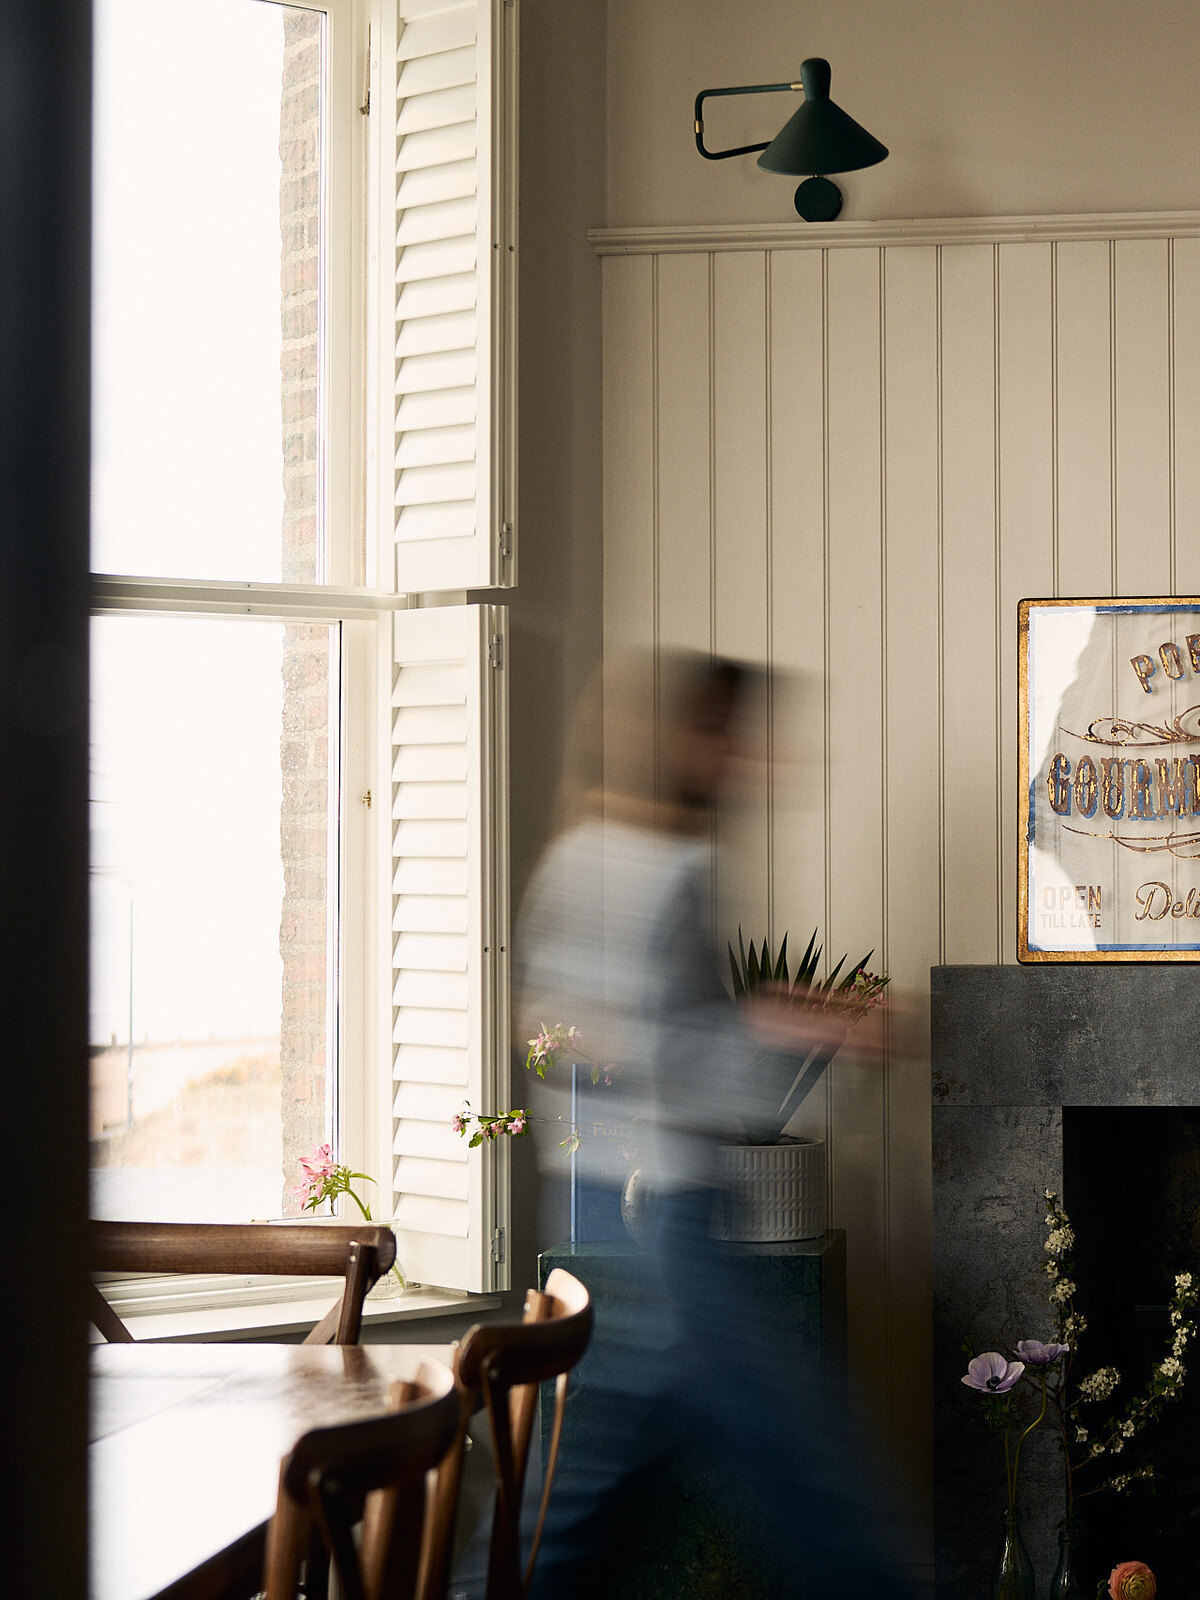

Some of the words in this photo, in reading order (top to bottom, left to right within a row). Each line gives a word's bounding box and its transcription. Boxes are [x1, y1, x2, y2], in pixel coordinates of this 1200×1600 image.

[1043, 885, 1102, 911] OPEN
[1042, 913, 1067, 928] TILL
[1071, 913, 1102, 928] LATE
